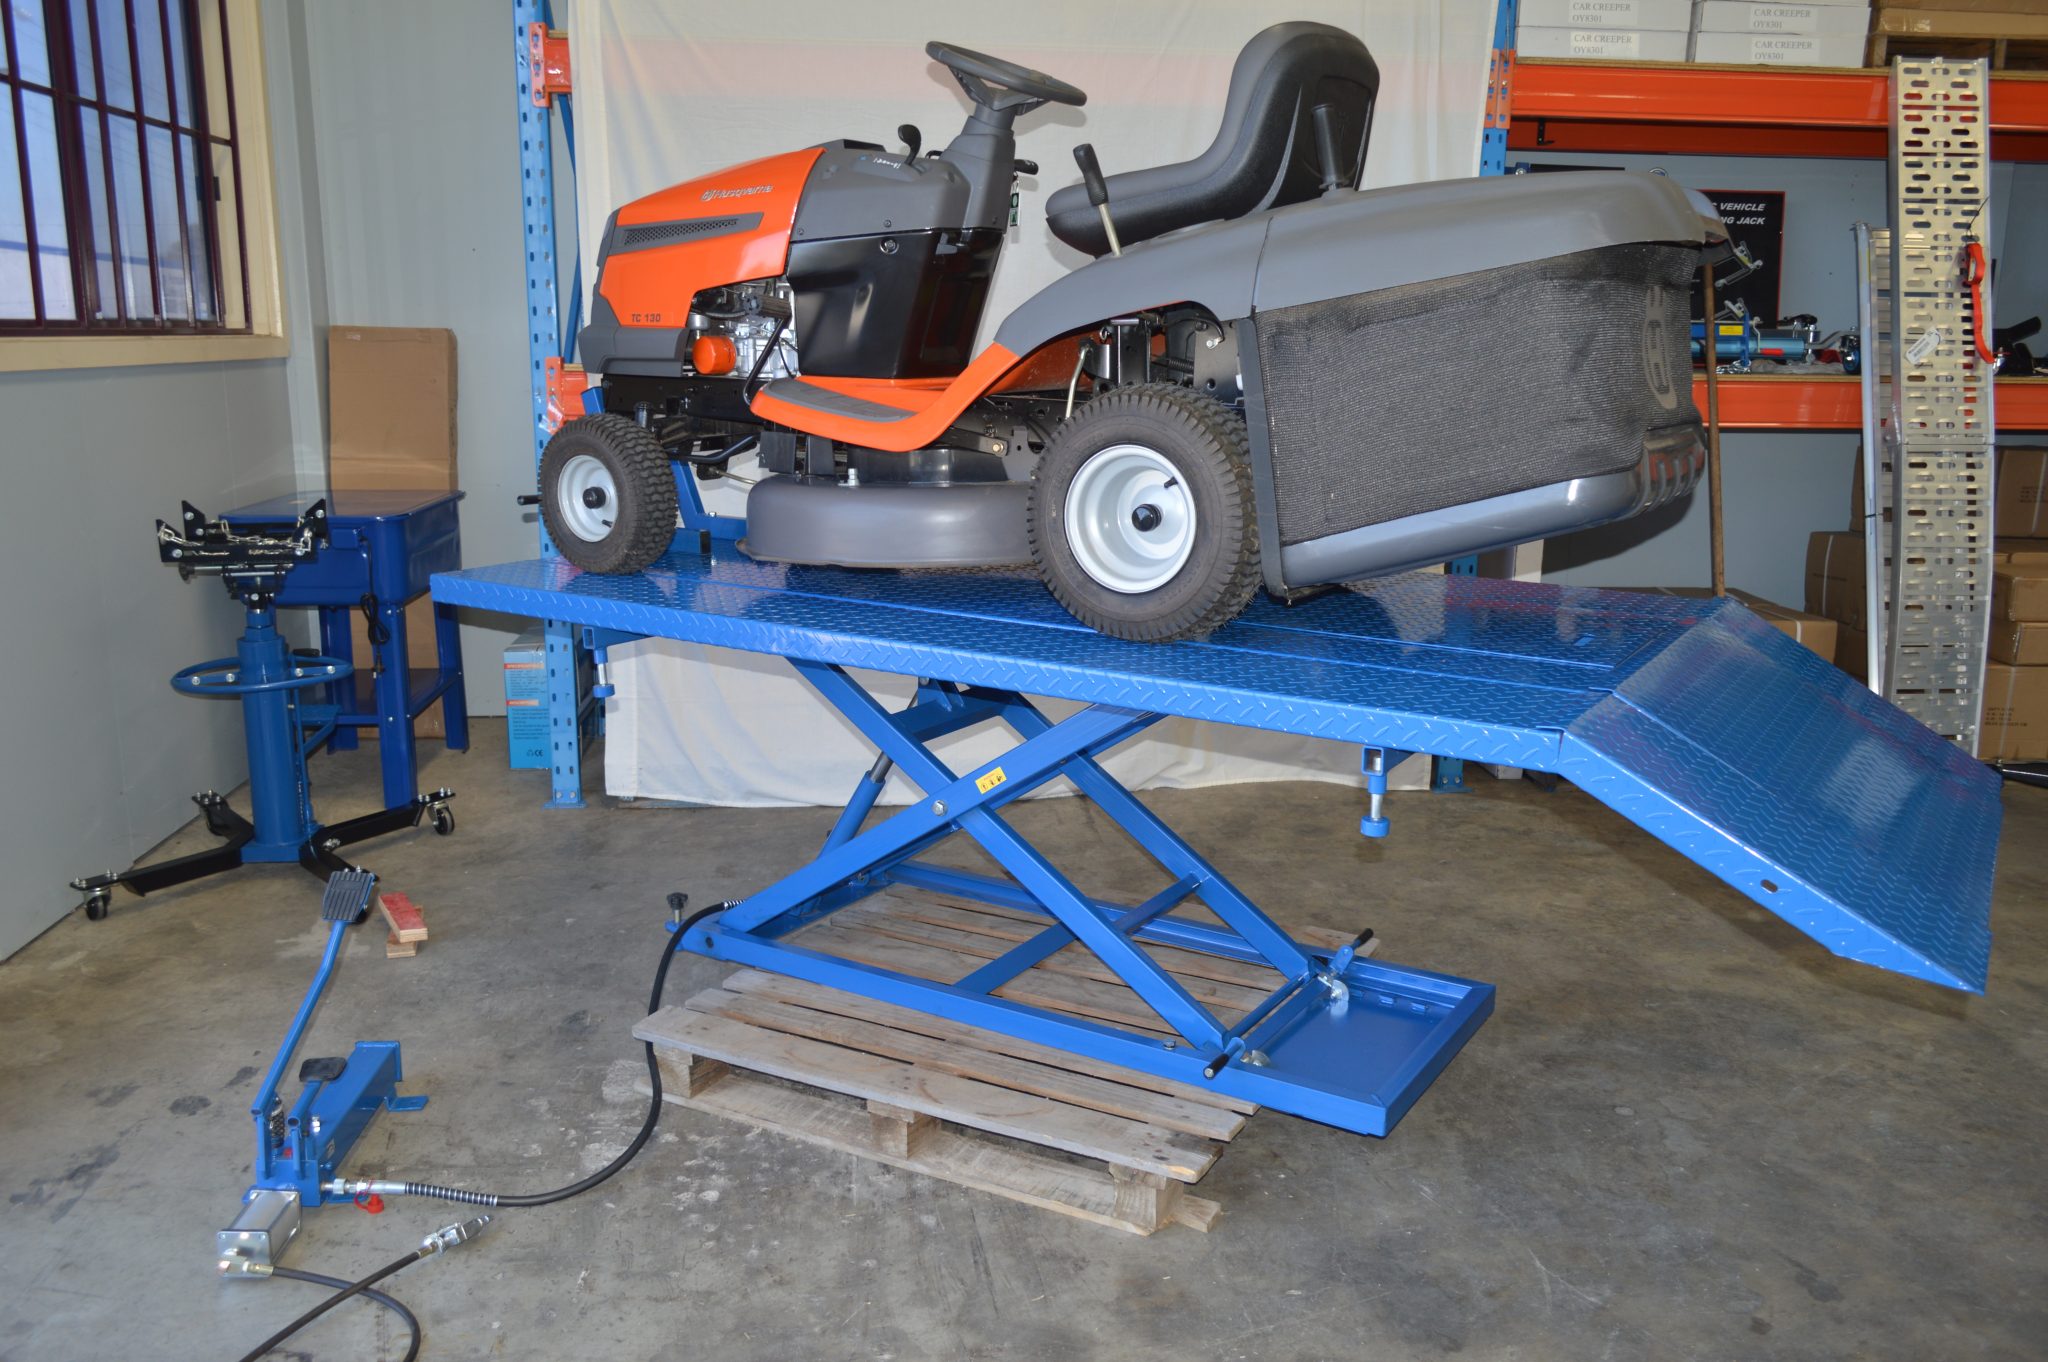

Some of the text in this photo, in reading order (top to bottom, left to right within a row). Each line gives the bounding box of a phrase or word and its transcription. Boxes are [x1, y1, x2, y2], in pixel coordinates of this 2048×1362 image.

[1572, 2, 1632, 12] CAR CREEPER
[1753, 8, 1811, 18] CAR CREEPER
[1572, 14, 1602, 23] OY8301
[1574, 33, 1632, 44] CAR CREEPER
[1754, 40, 1813, 50] CAR CREEPER
[1720, 203, 1766, 211] VEHICLE
[1736, 217, 1766, 225] JACK
[632, 313, 661, 322] TC 130
